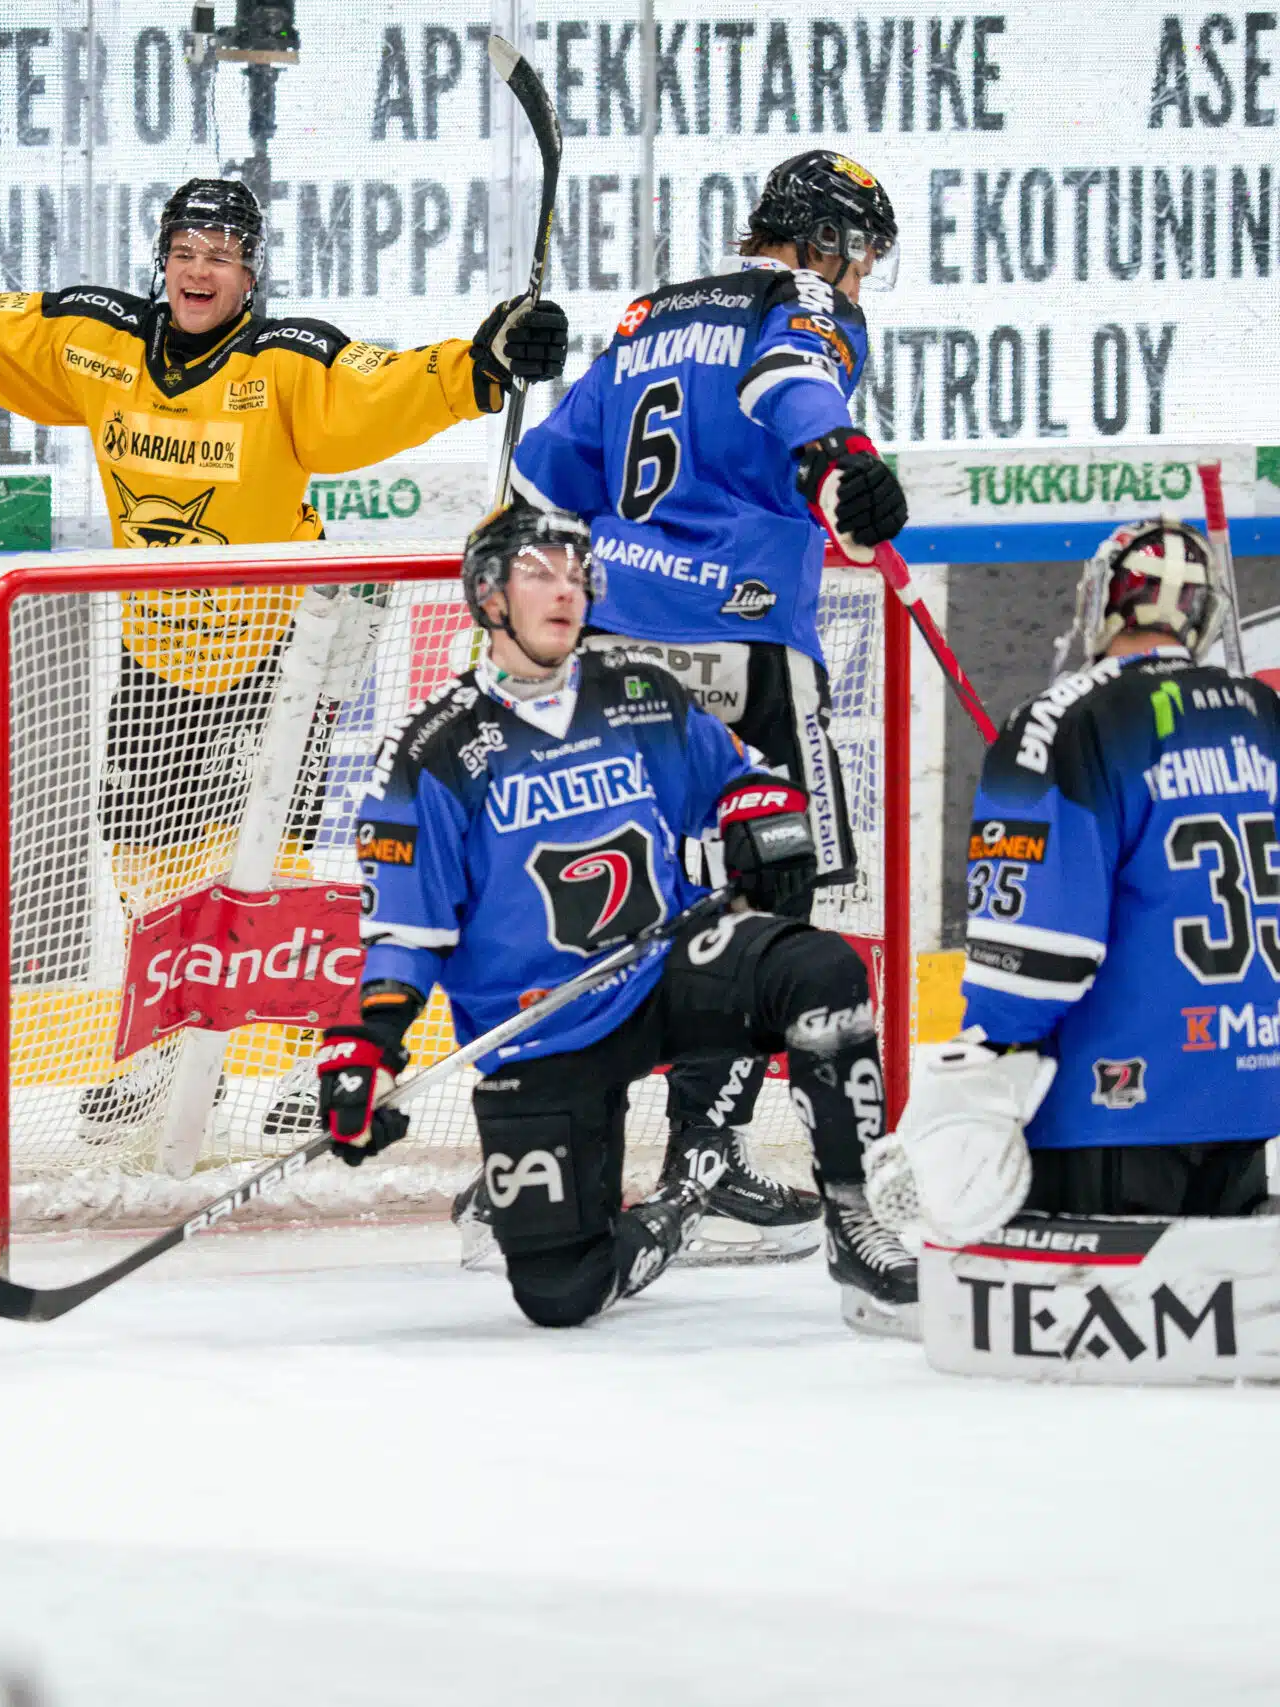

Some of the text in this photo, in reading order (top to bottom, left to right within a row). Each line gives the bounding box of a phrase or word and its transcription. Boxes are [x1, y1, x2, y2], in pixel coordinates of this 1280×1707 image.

[370, 15, 1005, 141] APTEKKITARVIKE
[1092, 322, 1177, 436] OY
[131, 431, 196, 465] KARJALA
[617, 376, 684, 523] 6
[308, 478, 422, 521] TALO
[965, 461, 1193, 505] TUKKUTALO
[593, 536, 729, 590] MARINE.FI
[965, 863, 1027, 920] 35
[143, 926, 362, 1008] Scandic
[486, 1149, 565, 1209] GA
[957, 1274, 1238, 1362] TEAM
